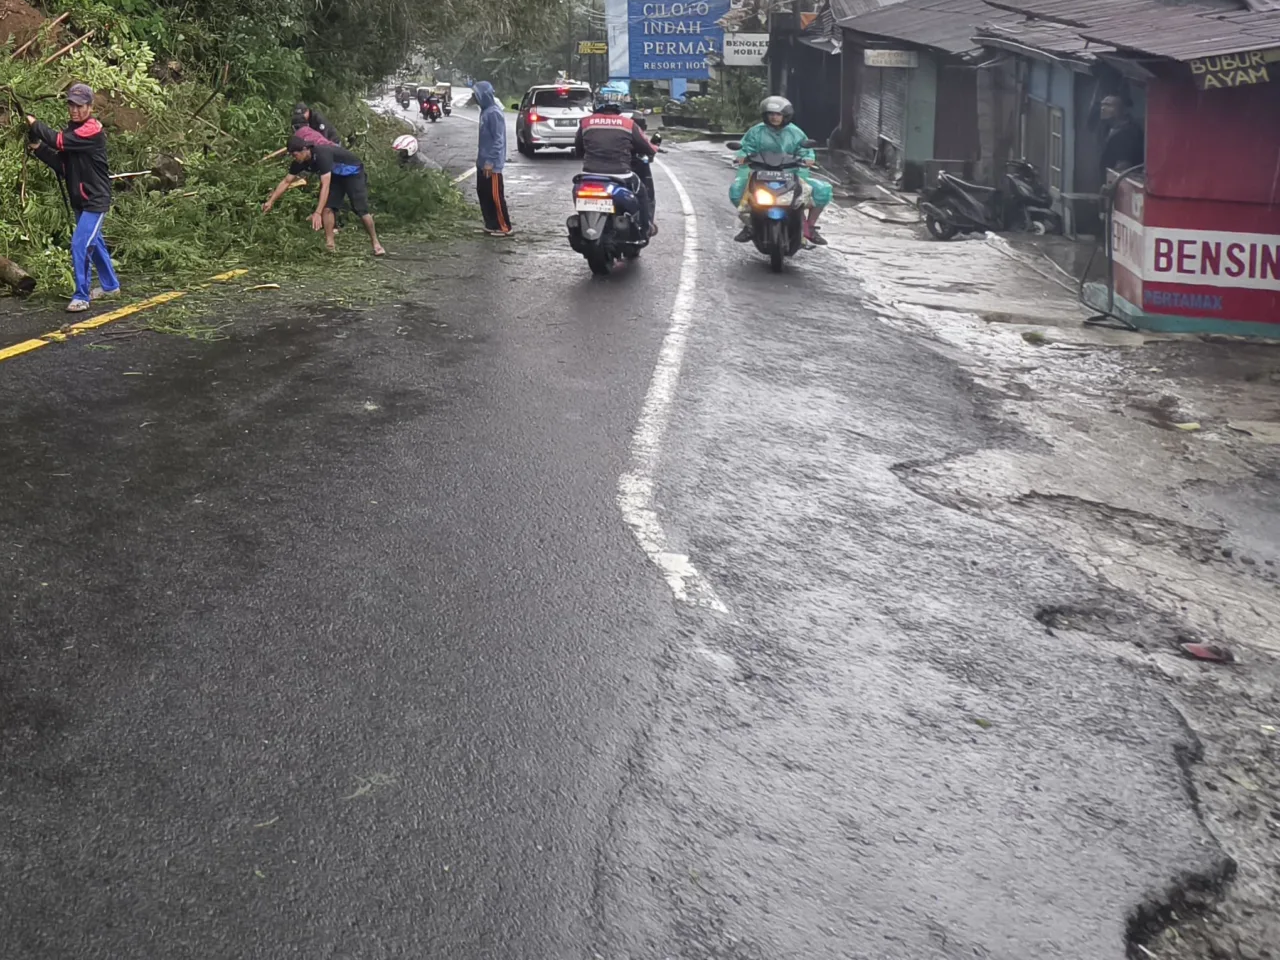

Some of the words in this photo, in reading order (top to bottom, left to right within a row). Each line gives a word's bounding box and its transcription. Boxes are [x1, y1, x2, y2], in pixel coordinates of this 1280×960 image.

[643, 2, 709, 17] CILOTO
[643, 21, 701, 35] INDAH
[733, 48, 763, 56] MOBIL
[643, 61, 682, 70] RESORT
[1190, 50, 1266, 74] BUBUR
[1204, 66, 1270, 90] AYAM
[1154, 237, 1280, 280] BENSIN
[1144, 290, 1223, 311] PERTAMAX
